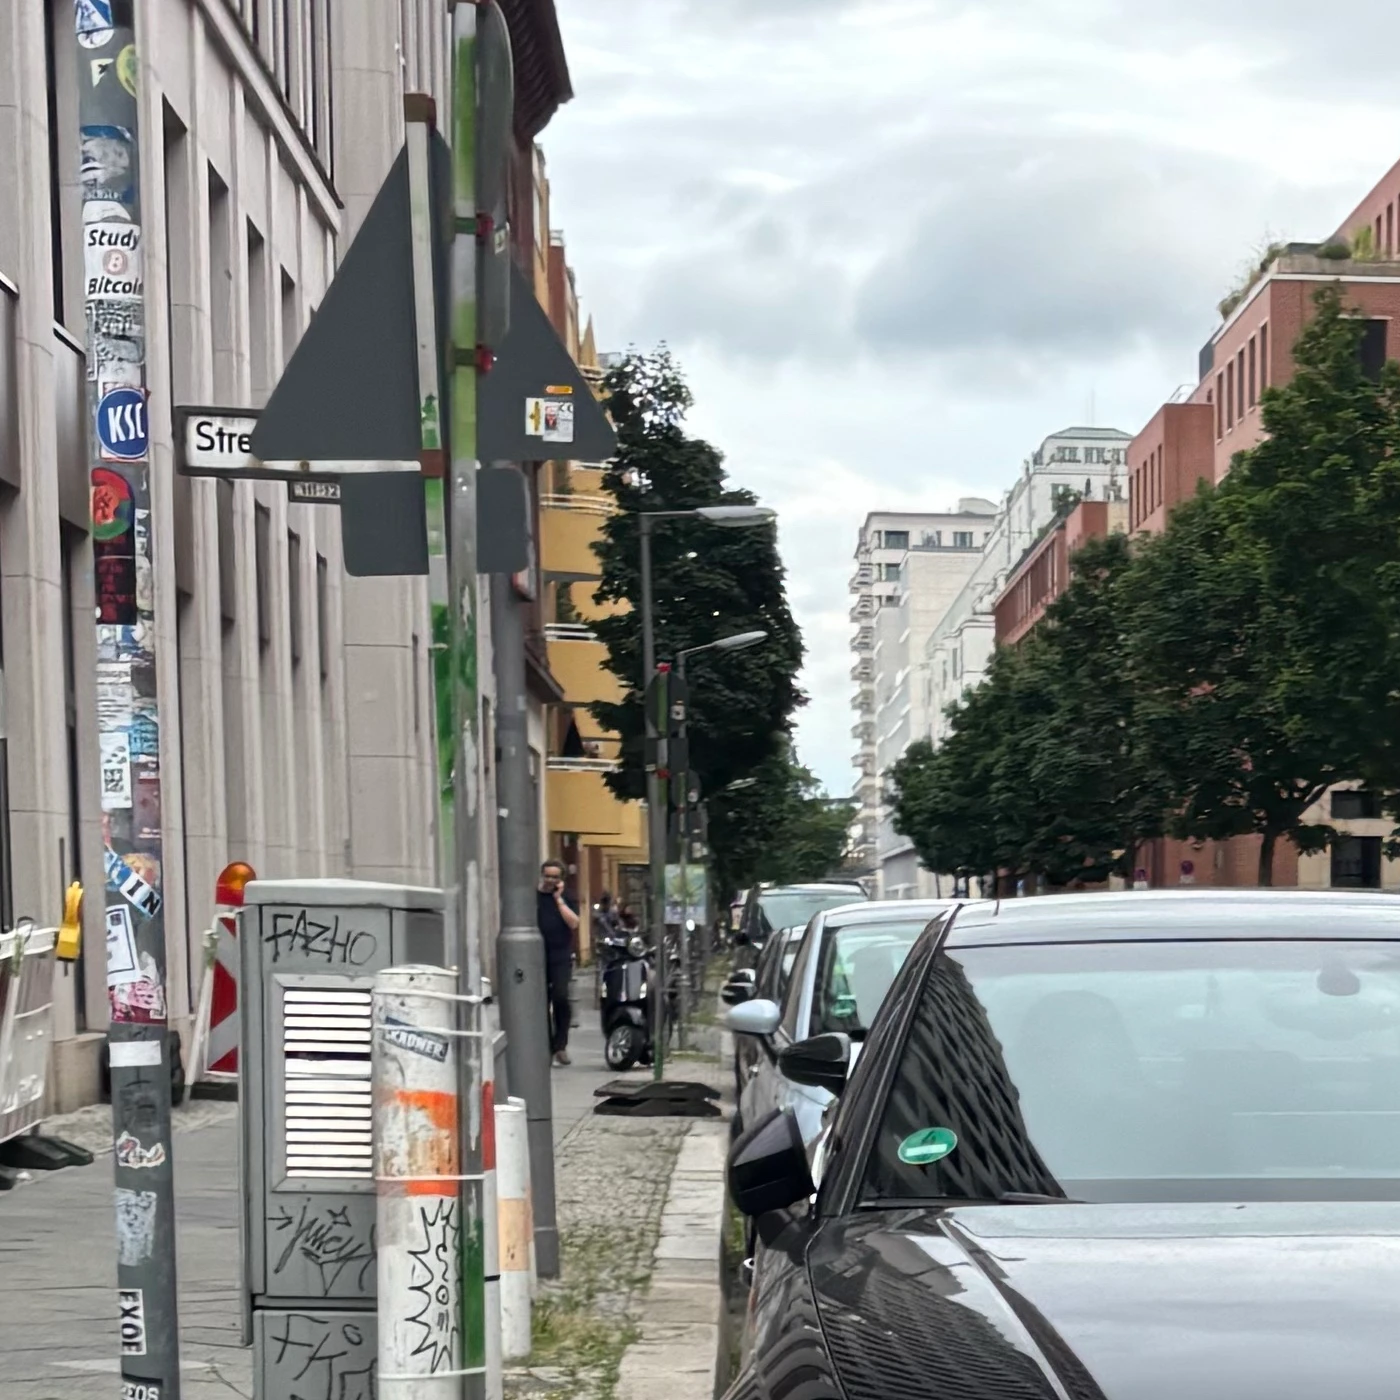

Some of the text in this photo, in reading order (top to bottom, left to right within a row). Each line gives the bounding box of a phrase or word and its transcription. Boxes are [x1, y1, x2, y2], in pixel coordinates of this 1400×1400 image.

[88, 229, 140, 251] Study
[108, 402, 145, 443] KSC
[196, 421, 252, 453] Stre
